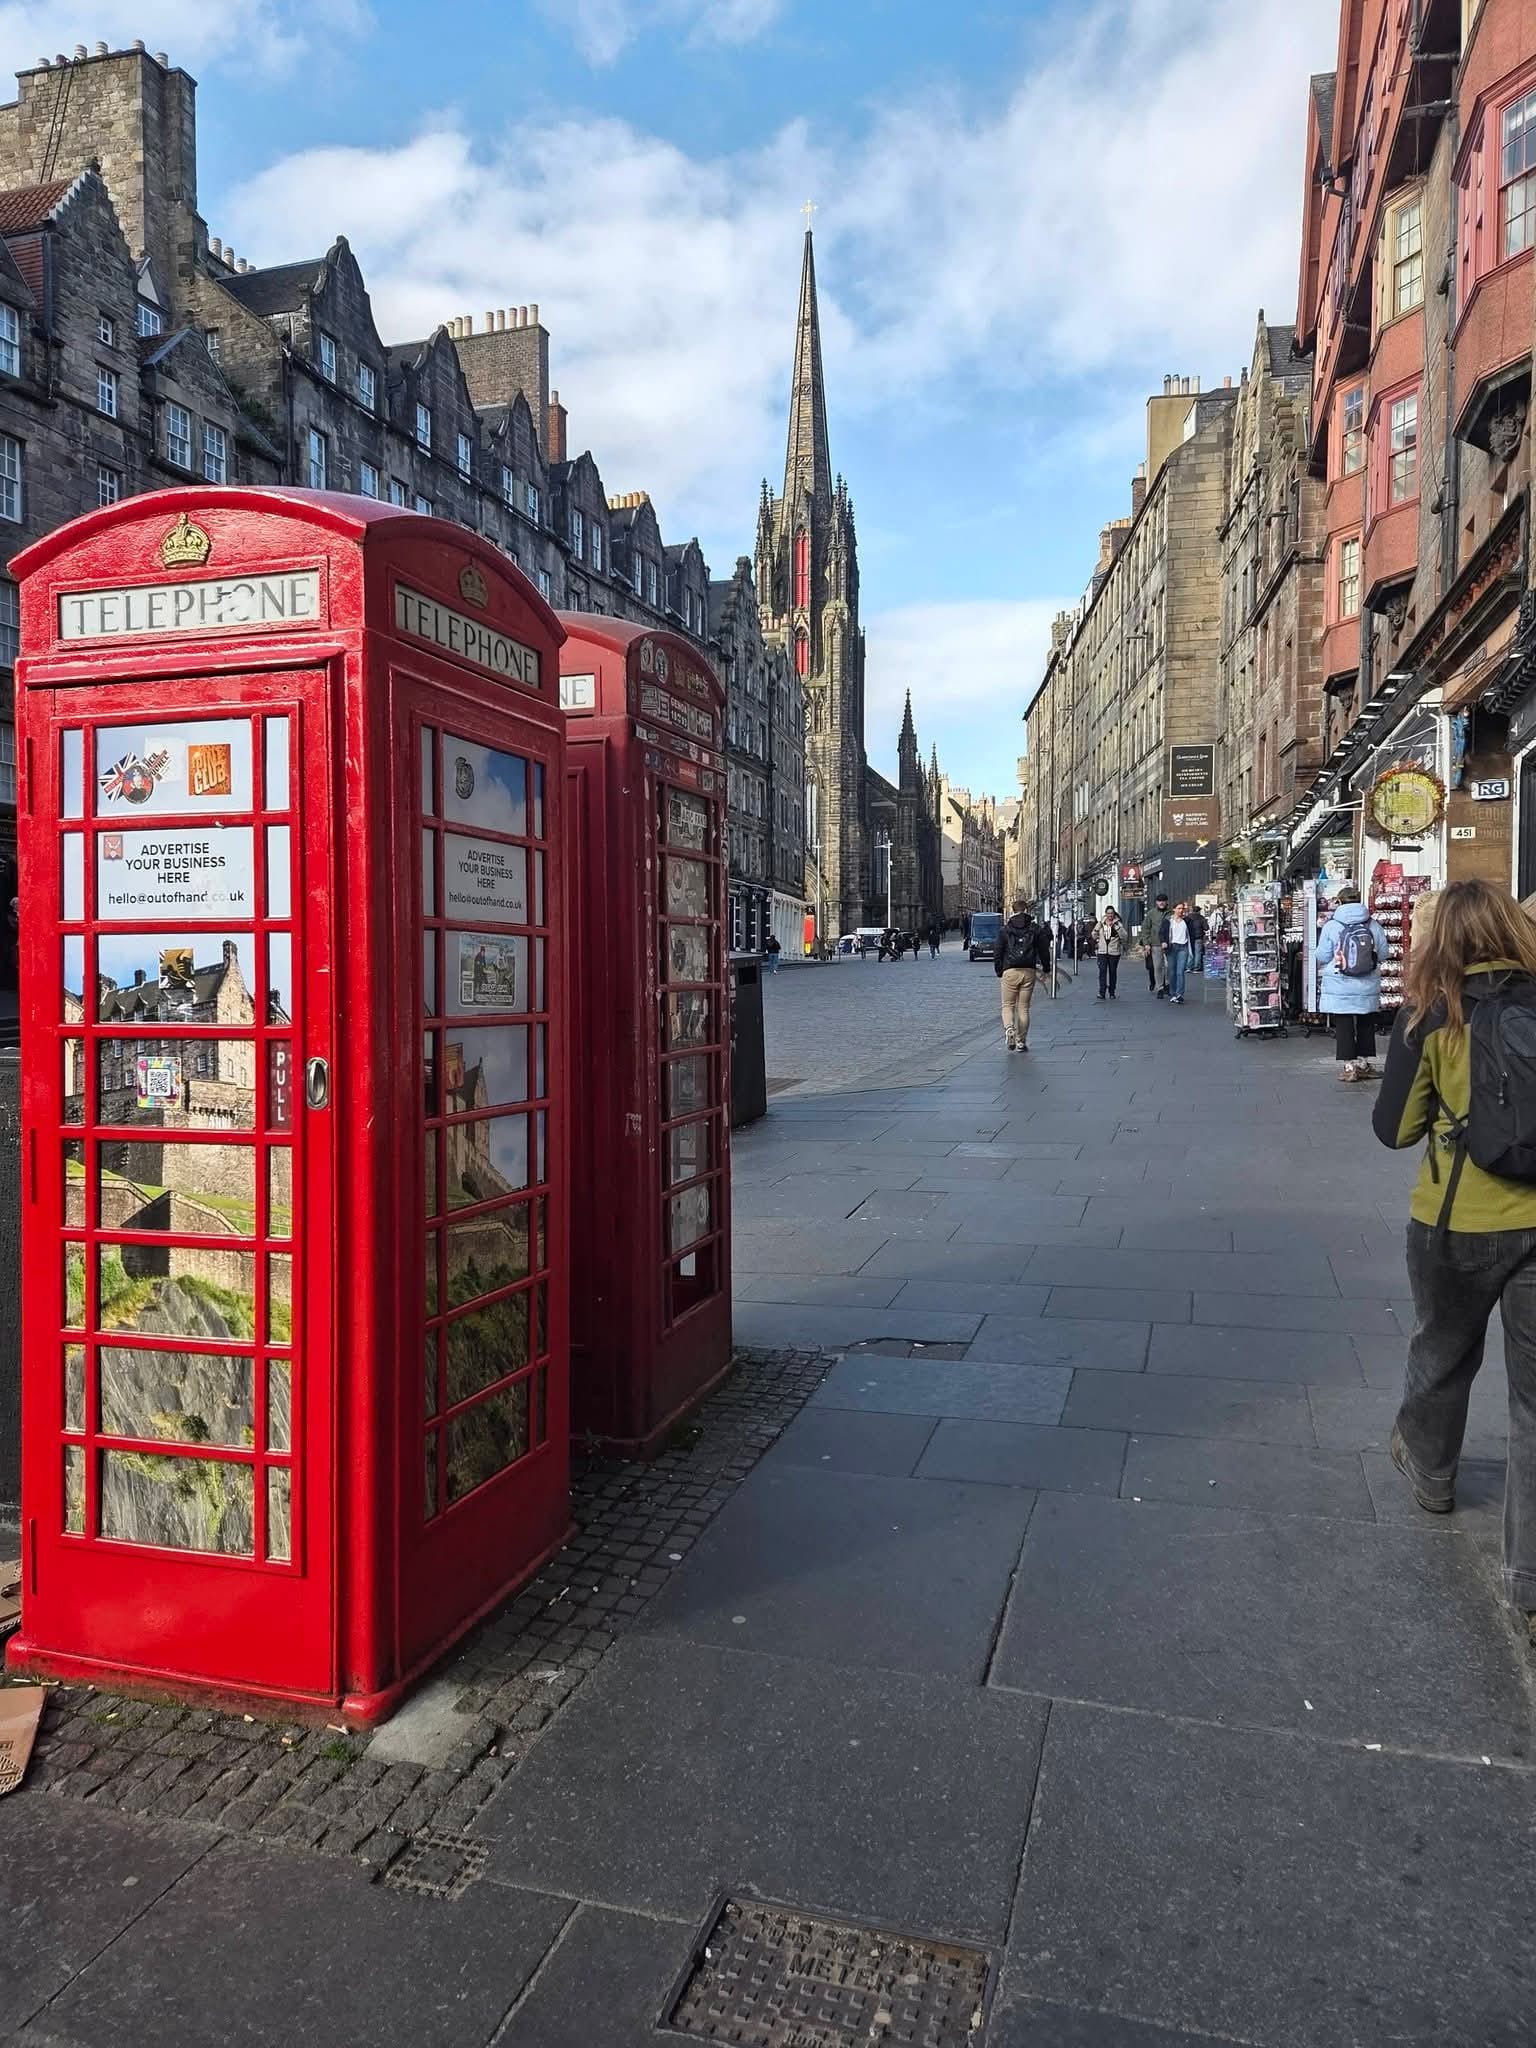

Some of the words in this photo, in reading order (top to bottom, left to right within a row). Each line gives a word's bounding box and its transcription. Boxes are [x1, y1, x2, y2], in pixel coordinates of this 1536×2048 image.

[71, 577, 311, 635] TELEPHONE
[398, 591, 534, 686] TELEPHONE
[1480, 783, 1503, 795] RG
[1456, 828, 1472, 837] 451
[140, 842, 210, 856] ADVERTISE
[126, 859, 160, 871] YOUR
[163, 856, 226, 869] BUSINESS
[467, 849, 505, 866] ADVERTISE
[157, 871, 190, 884] HERE
[458, 860, 480, 874] YOUR
[480, 865, 513, 880] BUSINESS
[477, 877, 496, 889] HERE
[448, 891, 522, 910] hello@outofhand.co.uk
[276, 1051, 286, 1122] PULL
